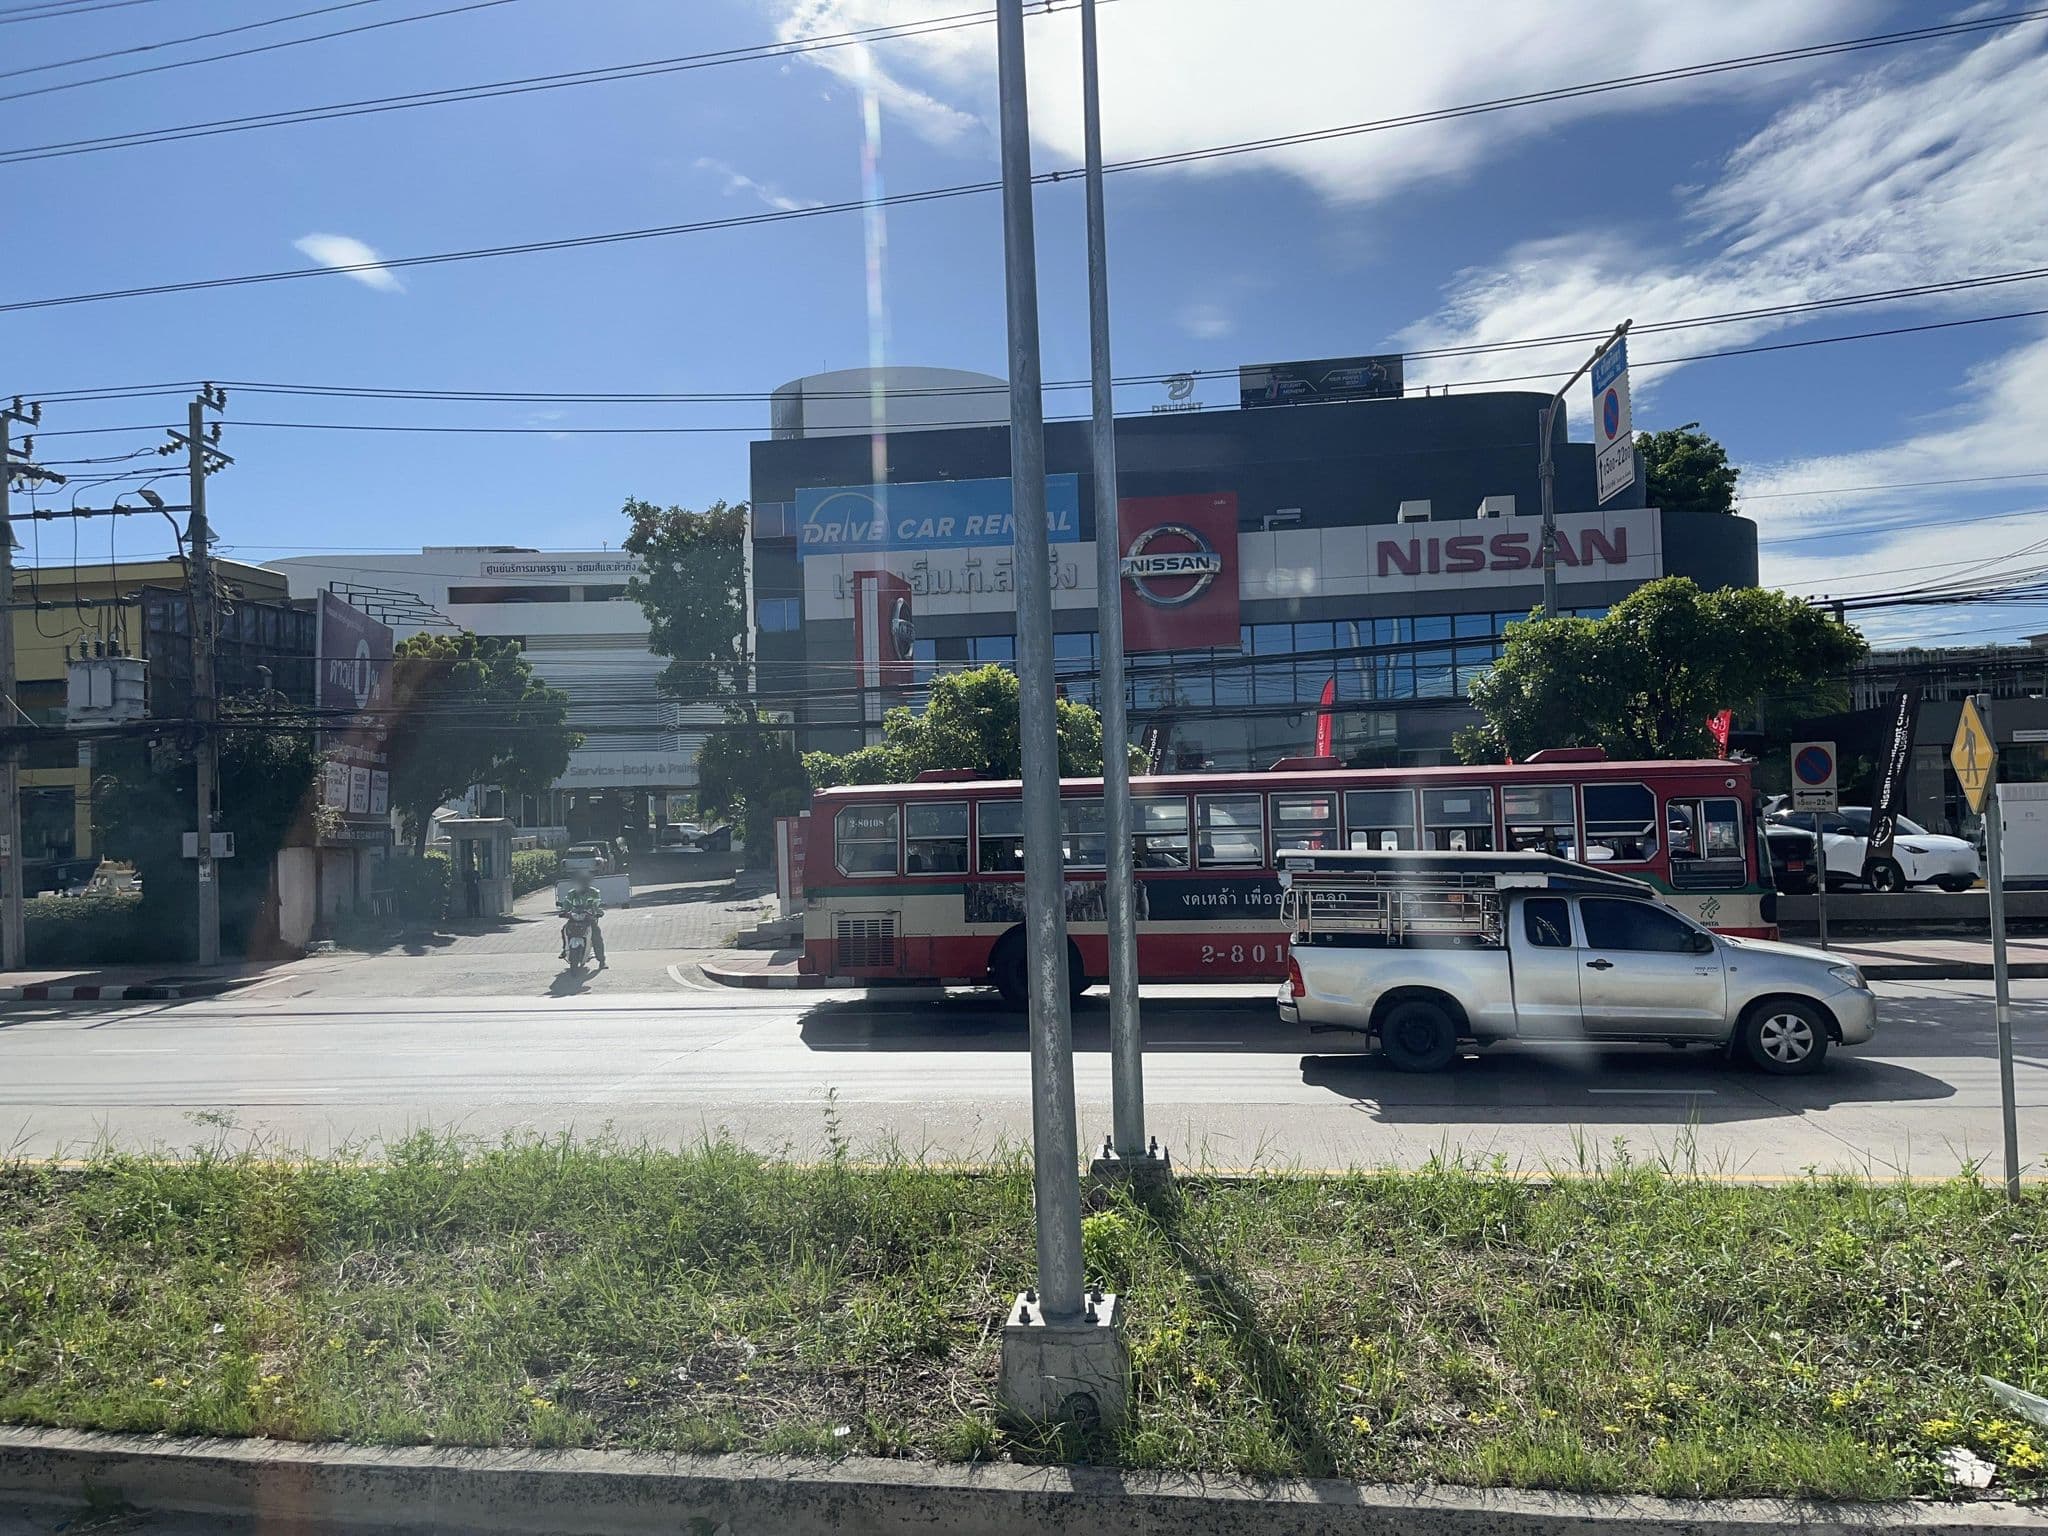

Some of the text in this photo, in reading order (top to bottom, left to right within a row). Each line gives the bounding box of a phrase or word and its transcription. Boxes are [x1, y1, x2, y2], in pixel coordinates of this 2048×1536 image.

[802, 511, 1071, 544] DRIVE CAR RENAL
[1131, 555, 1210, 573] NISSAN
[1378, 527, 1627, 577] NISSAN
[577, 562, 637, 573] ซอมสีและตัวถัง
[1881, 777, 1891, 809] Nissan
[1182, 887, 1236, 905] งดเหล้า
